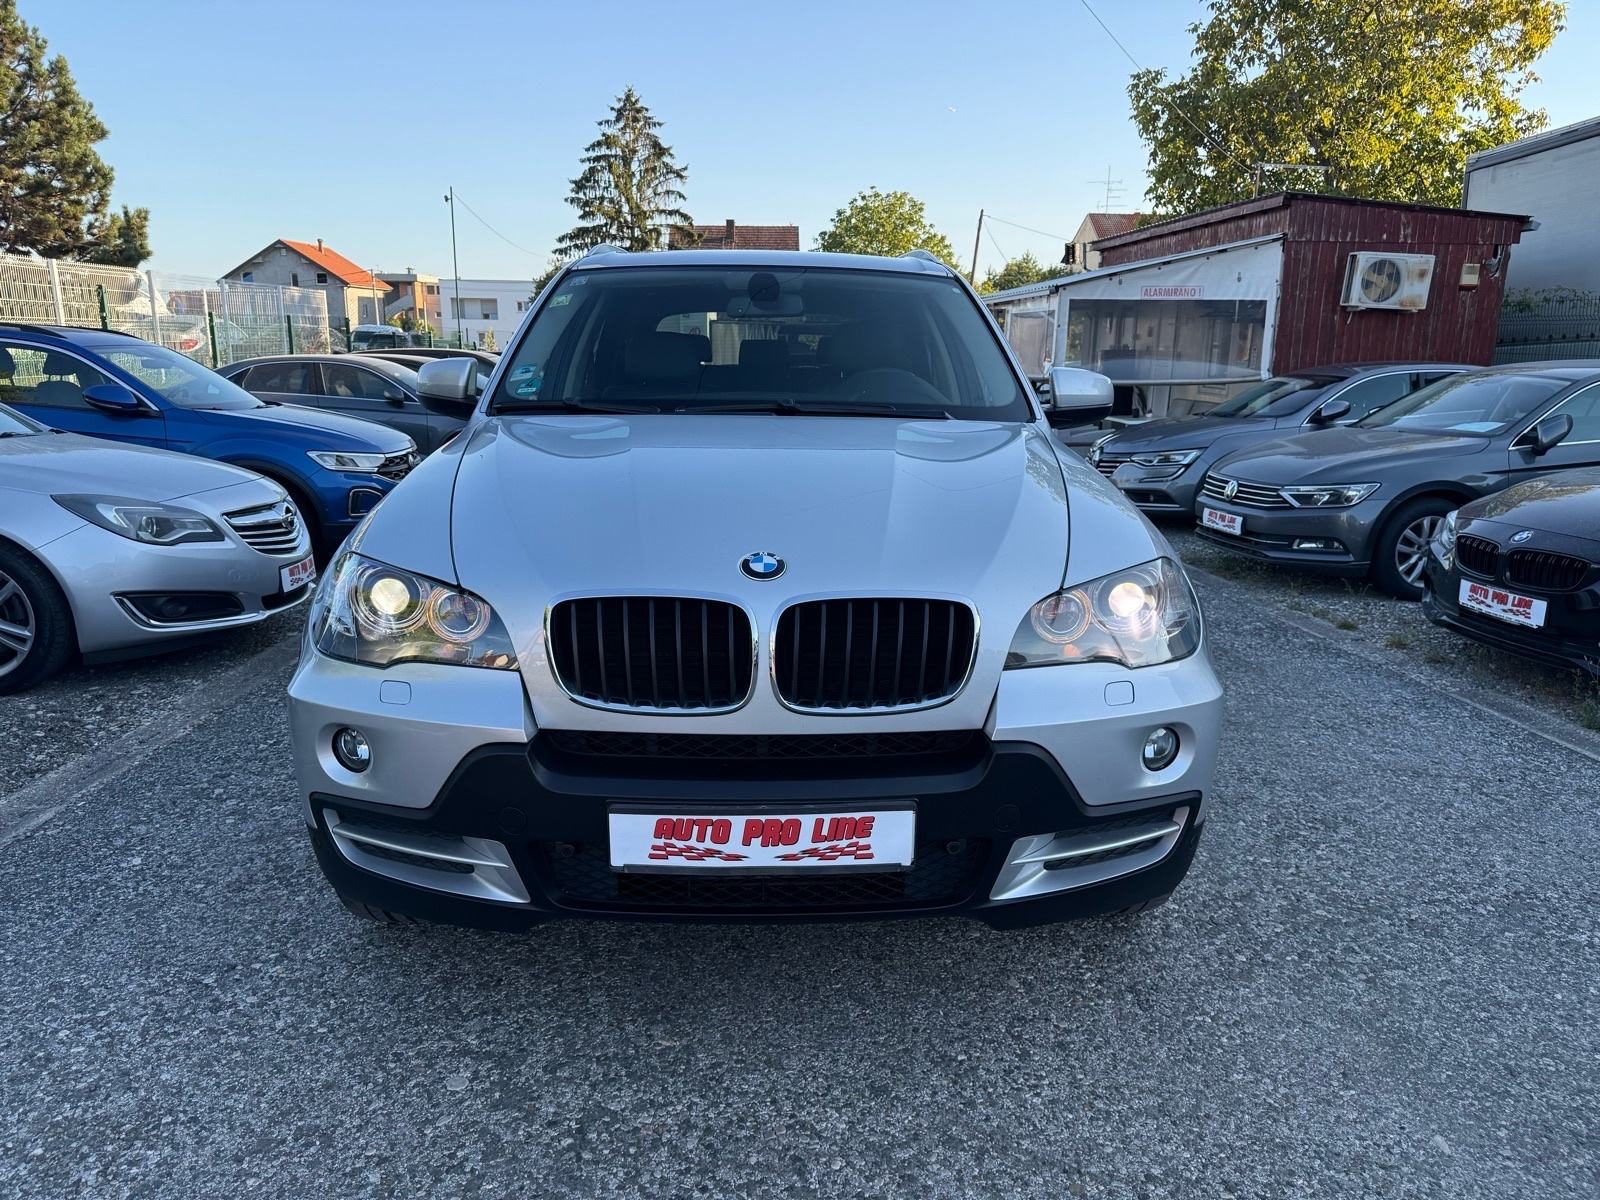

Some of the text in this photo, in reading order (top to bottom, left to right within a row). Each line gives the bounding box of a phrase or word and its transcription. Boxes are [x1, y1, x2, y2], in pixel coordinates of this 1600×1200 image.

[1143, 287, 1196, 297] ALARMIRANO
[1469, 584, 1489, 599] AUTO
[1491, 590, 1509, 606] PRO
[653, 816, 875, 847] AUTO PRO LINE
